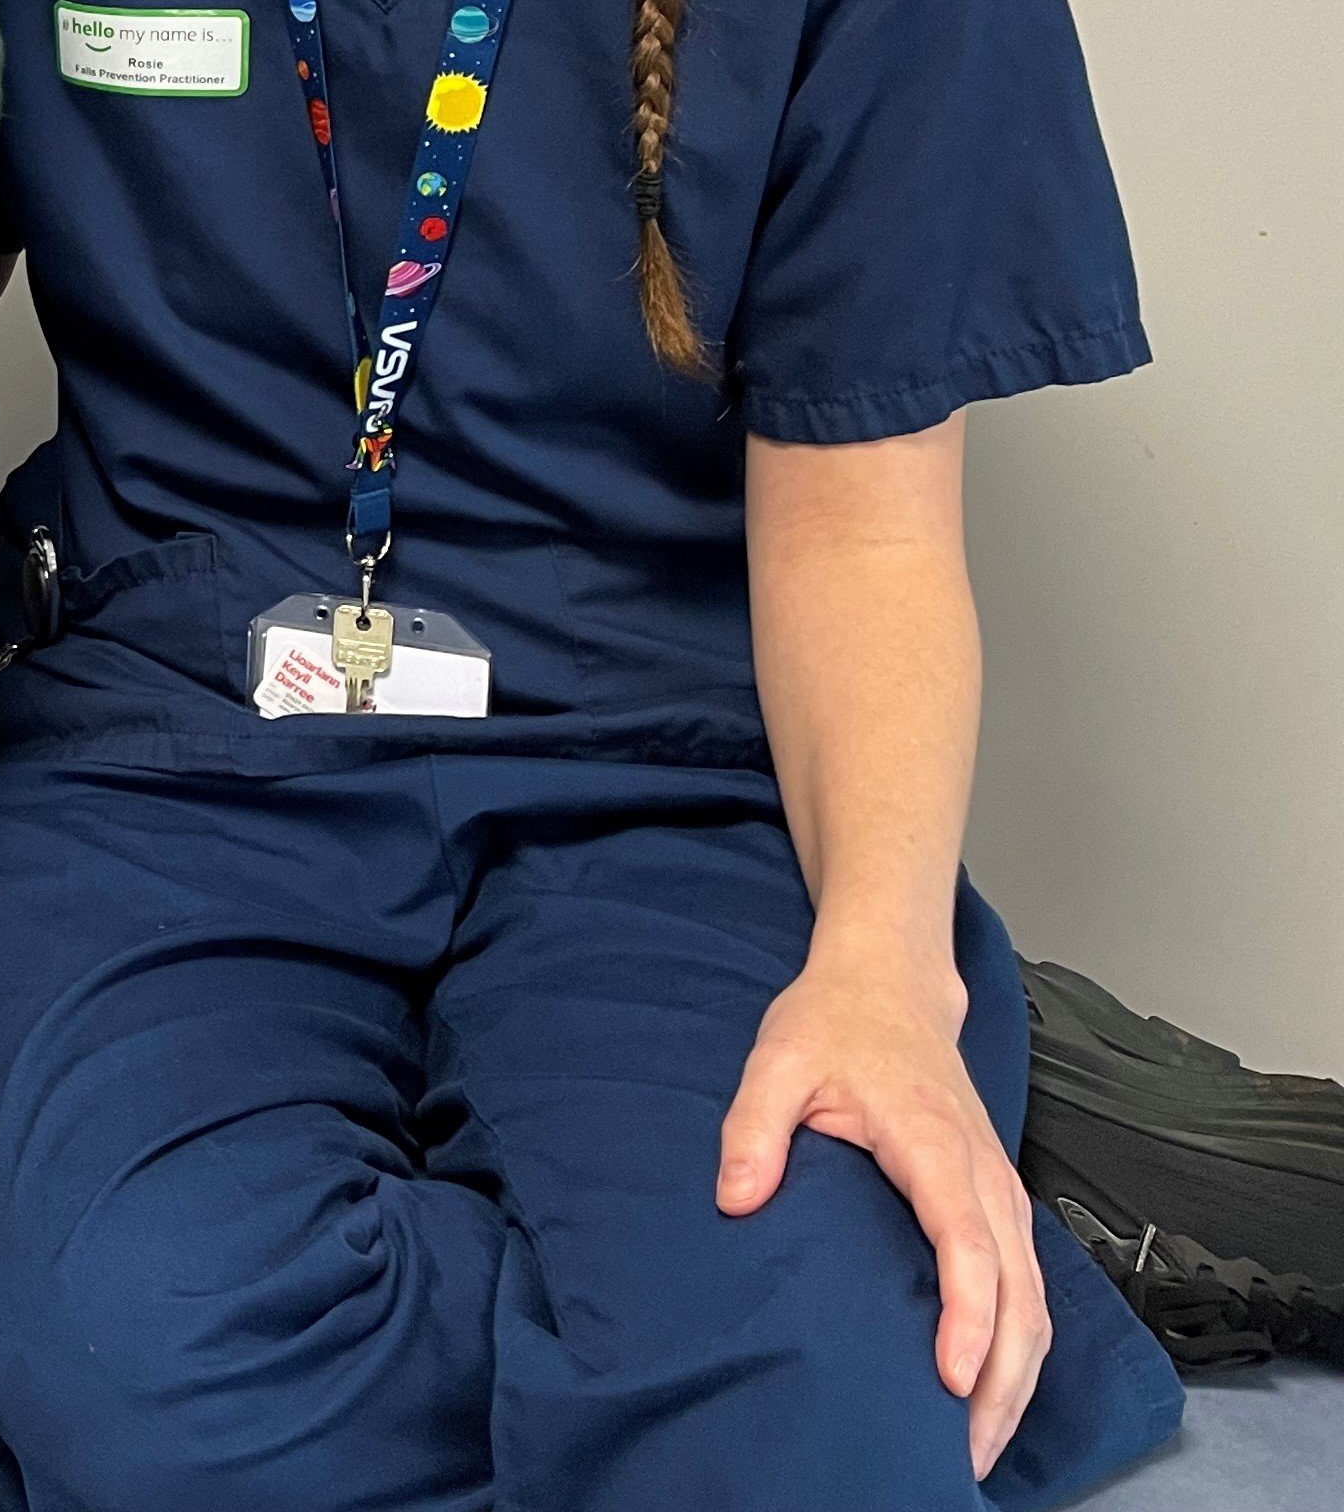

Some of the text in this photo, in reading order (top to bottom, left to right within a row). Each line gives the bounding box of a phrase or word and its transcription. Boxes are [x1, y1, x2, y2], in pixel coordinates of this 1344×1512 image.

[72, 17, 115, 38] hello
[119, 29, 145, 45] my
[150, 29, 197, 41] name
[75, 64, 225, 84] Falls Prevention Practitioner
[128, 57, 164, 69] Rosie
[275, 672, 314, 703] Darree
